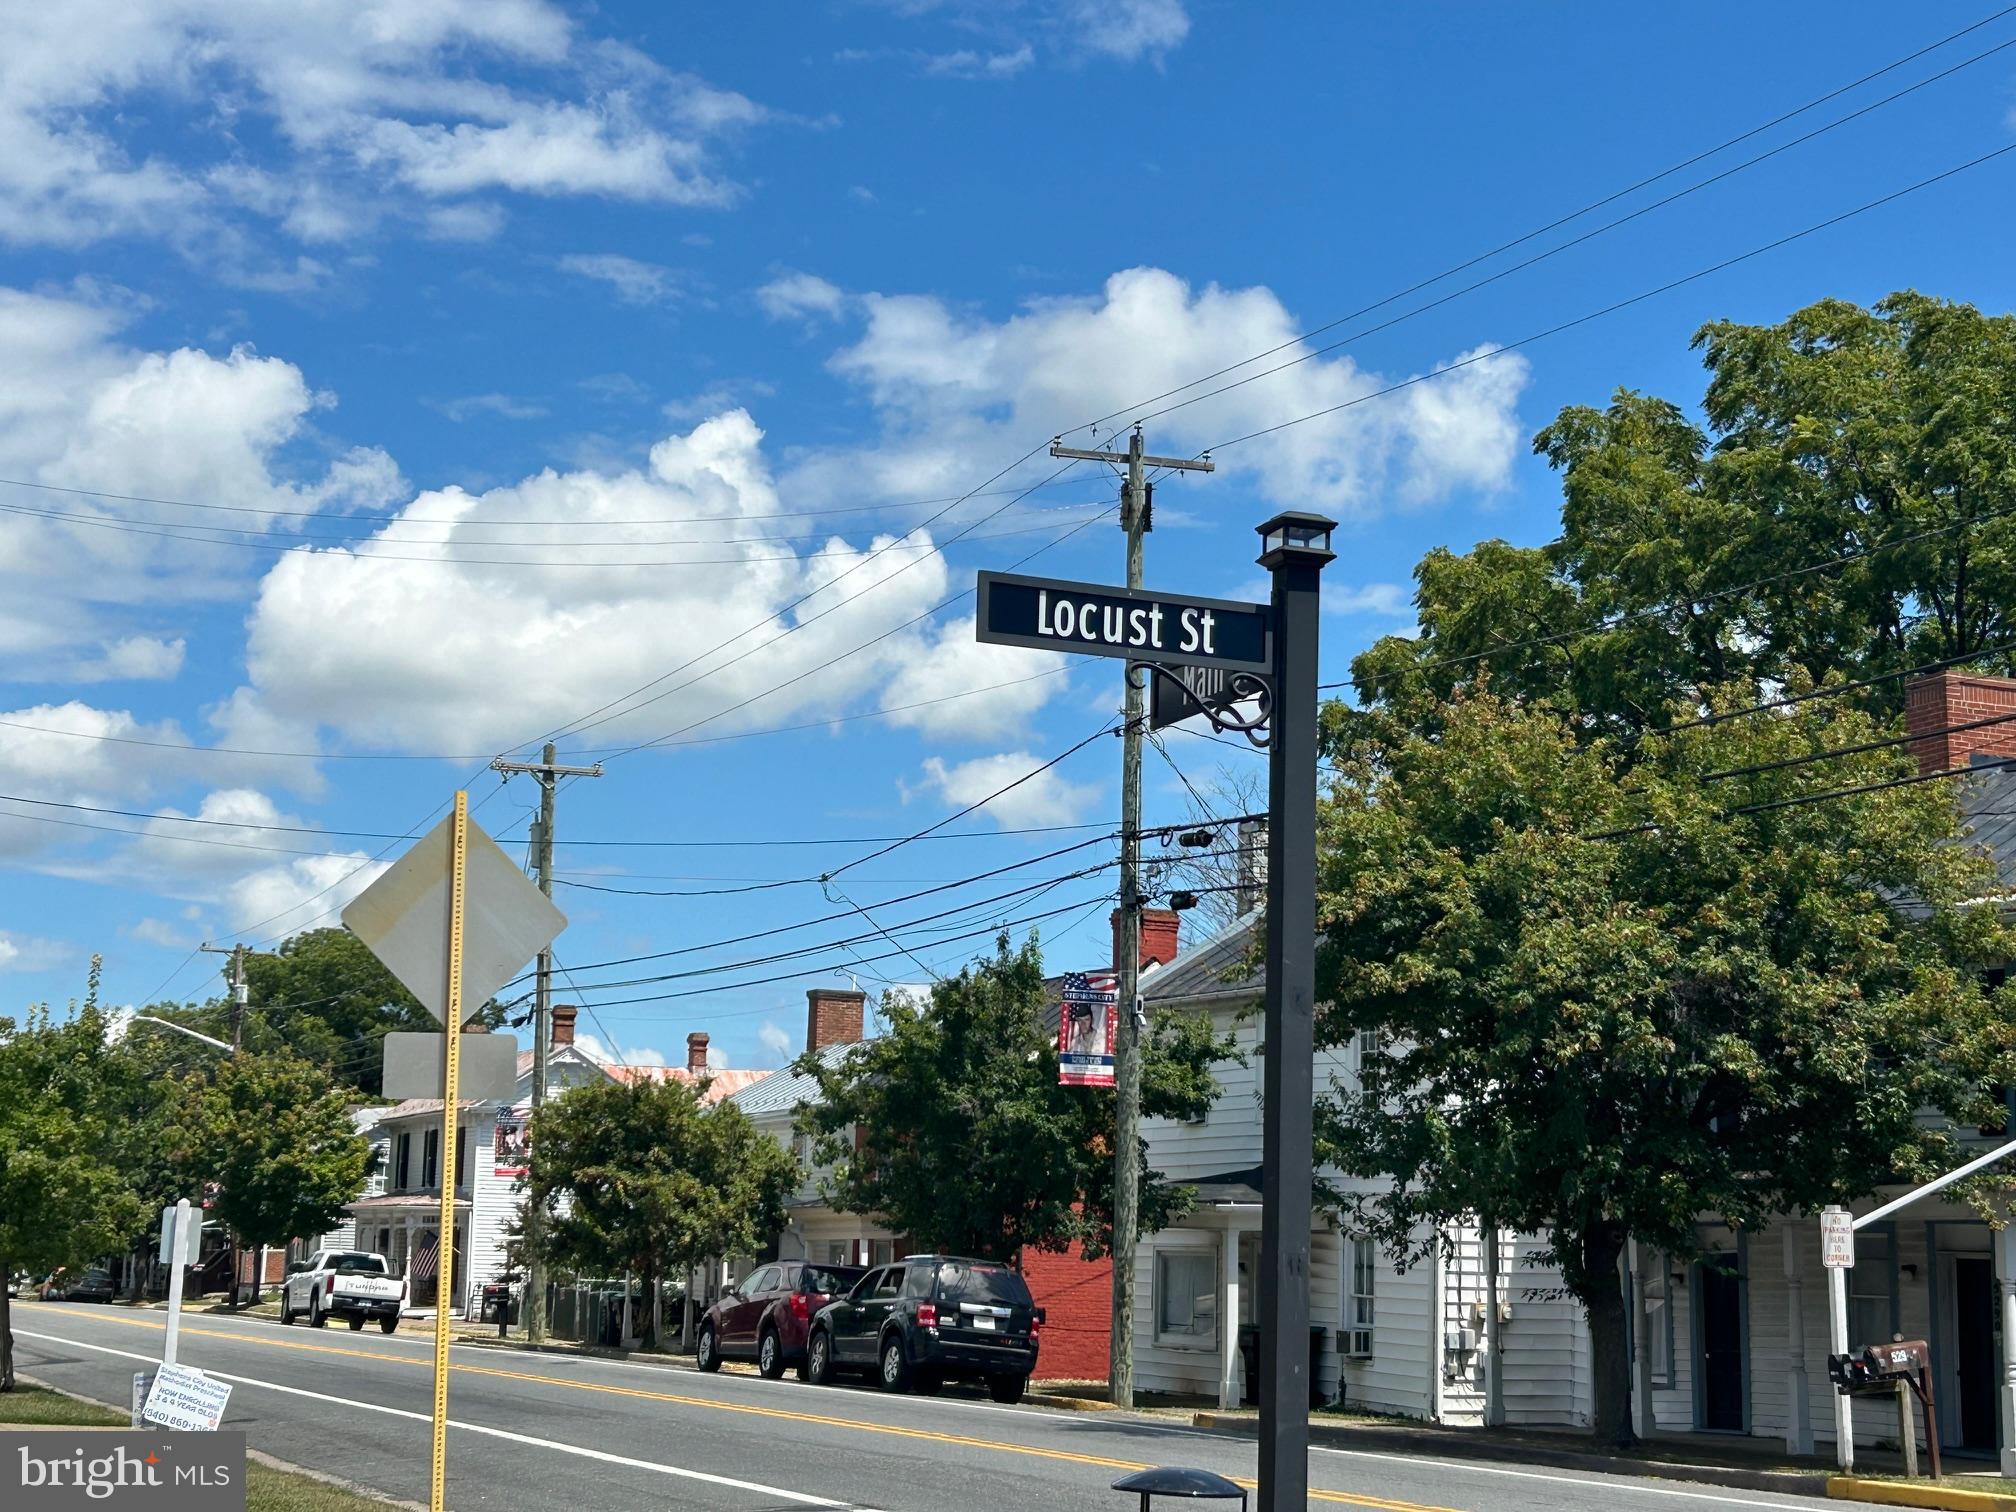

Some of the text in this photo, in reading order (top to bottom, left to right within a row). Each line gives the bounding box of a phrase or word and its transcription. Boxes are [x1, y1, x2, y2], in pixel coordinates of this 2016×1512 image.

[1038, 589, 1215, 654] Locust St
[1833, 1244, 1842, 1253] TO
[159, 1387, 178, 1397] NOW
[143, 1407, 169, 1423] (540)
